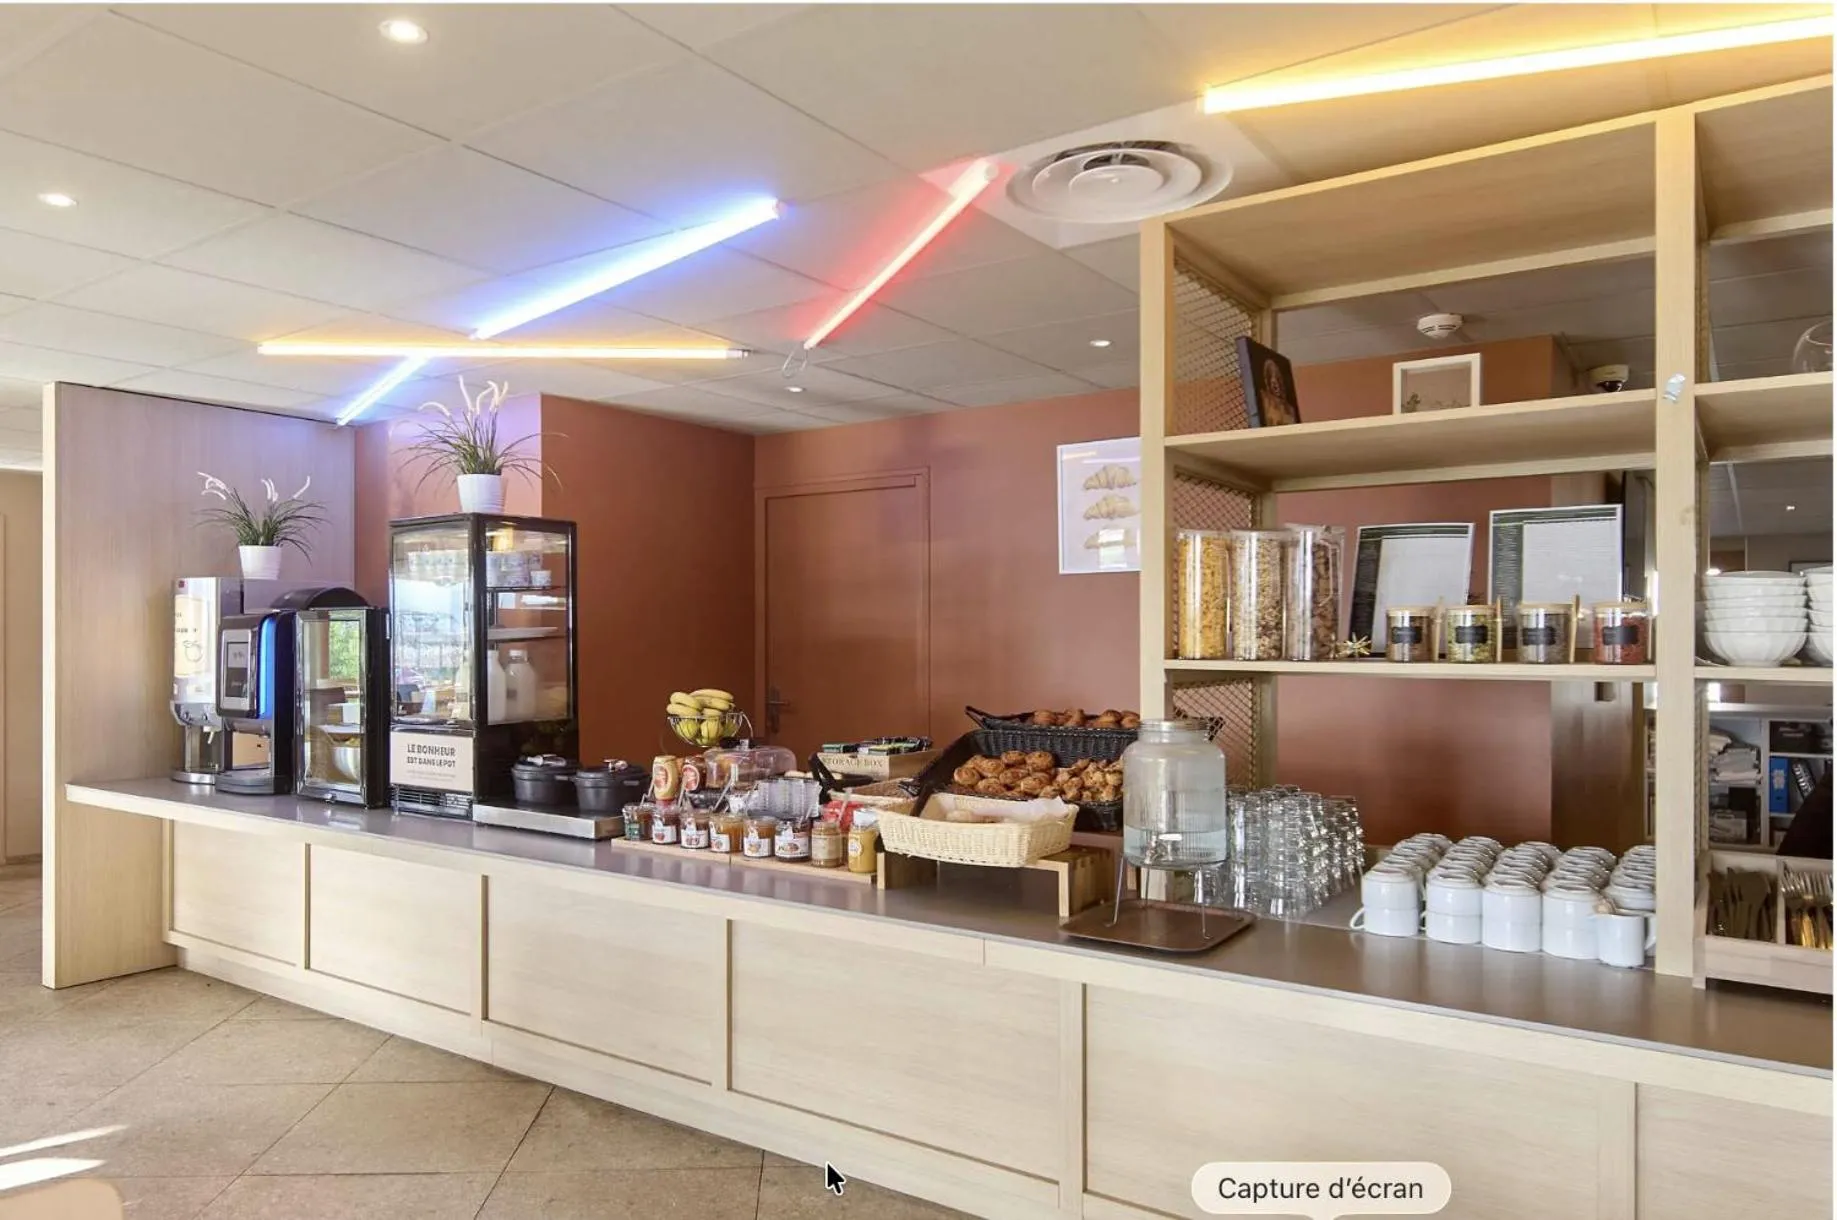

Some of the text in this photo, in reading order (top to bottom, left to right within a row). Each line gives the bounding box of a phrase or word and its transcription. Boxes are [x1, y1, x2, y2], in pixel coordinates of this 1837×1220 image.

[407, 744, 456, 756] LE BONHEUR
[407, 756, 417, 764] EST
[418, 758, 435, 766] DANS
[443, 760, 456, 768] POT
